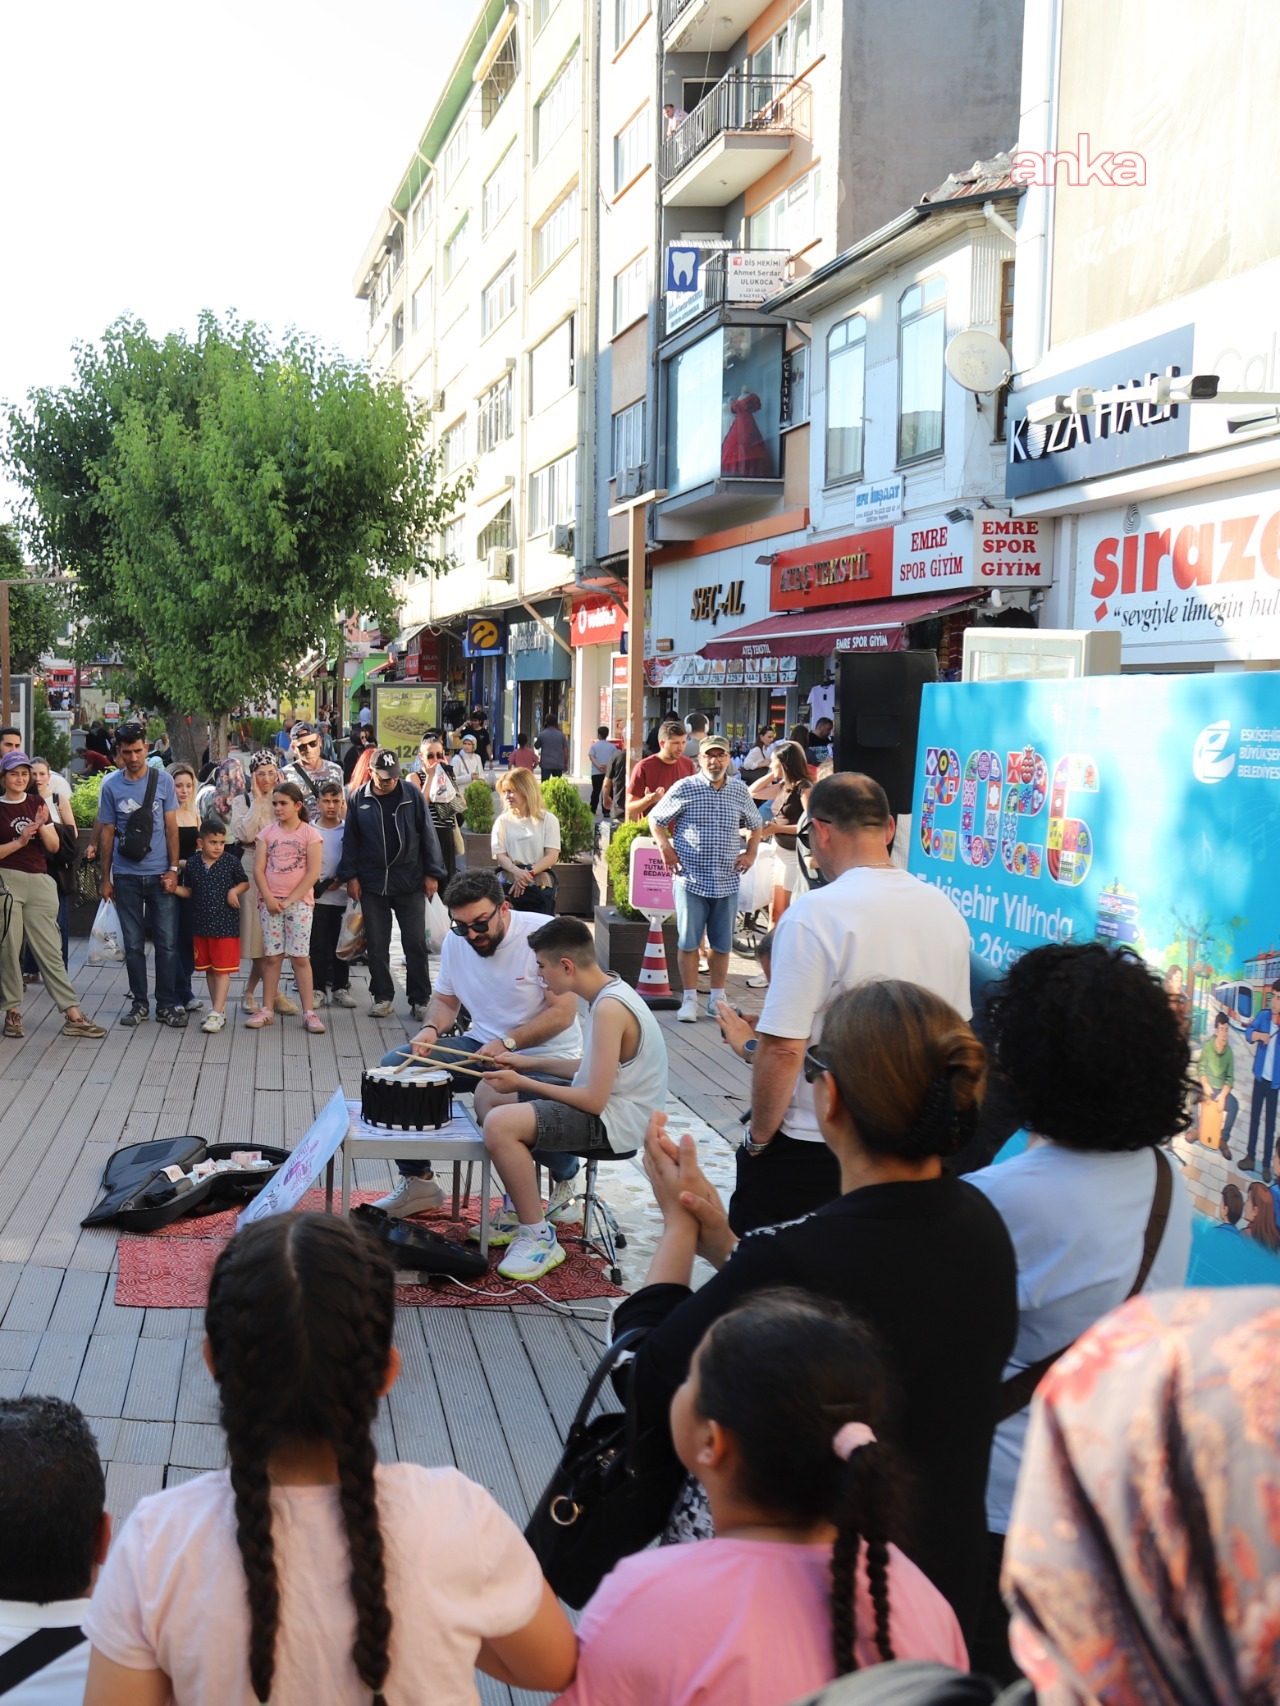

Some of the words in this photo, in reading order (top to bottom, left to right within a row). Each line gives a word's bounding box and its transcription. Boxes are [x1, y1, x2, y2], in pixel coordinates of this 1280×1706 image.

[744, 259, 755, 267] DİŞ
[757, 258, 781, 267] HEKİMİ
[733, 269, 757, 277] Ahmet
[757, 269, 781, 277] Serdar
[982, 520, 1039, 535] EMRE
[910, 526, 948, 552] EMRE
[982, 539, 1037, 553] SPOR
[779, 567, 813, 595] ATEŞ
[814, 547, 872, 587] TEKSTİL
[899, 561, 926, 581] SPOR
[930, 552, 963, 577] GİYİM
[981, 557, 1041, 576] GİYİM
[690, 580, 745, 626] SEÇ-AL
[836, 638, 851, 649] EMRE
[852, 636, 868, 648] SPOR
[869, 632, 888, 646] GİYİM
[920, 744, 1101, 888] 2026
